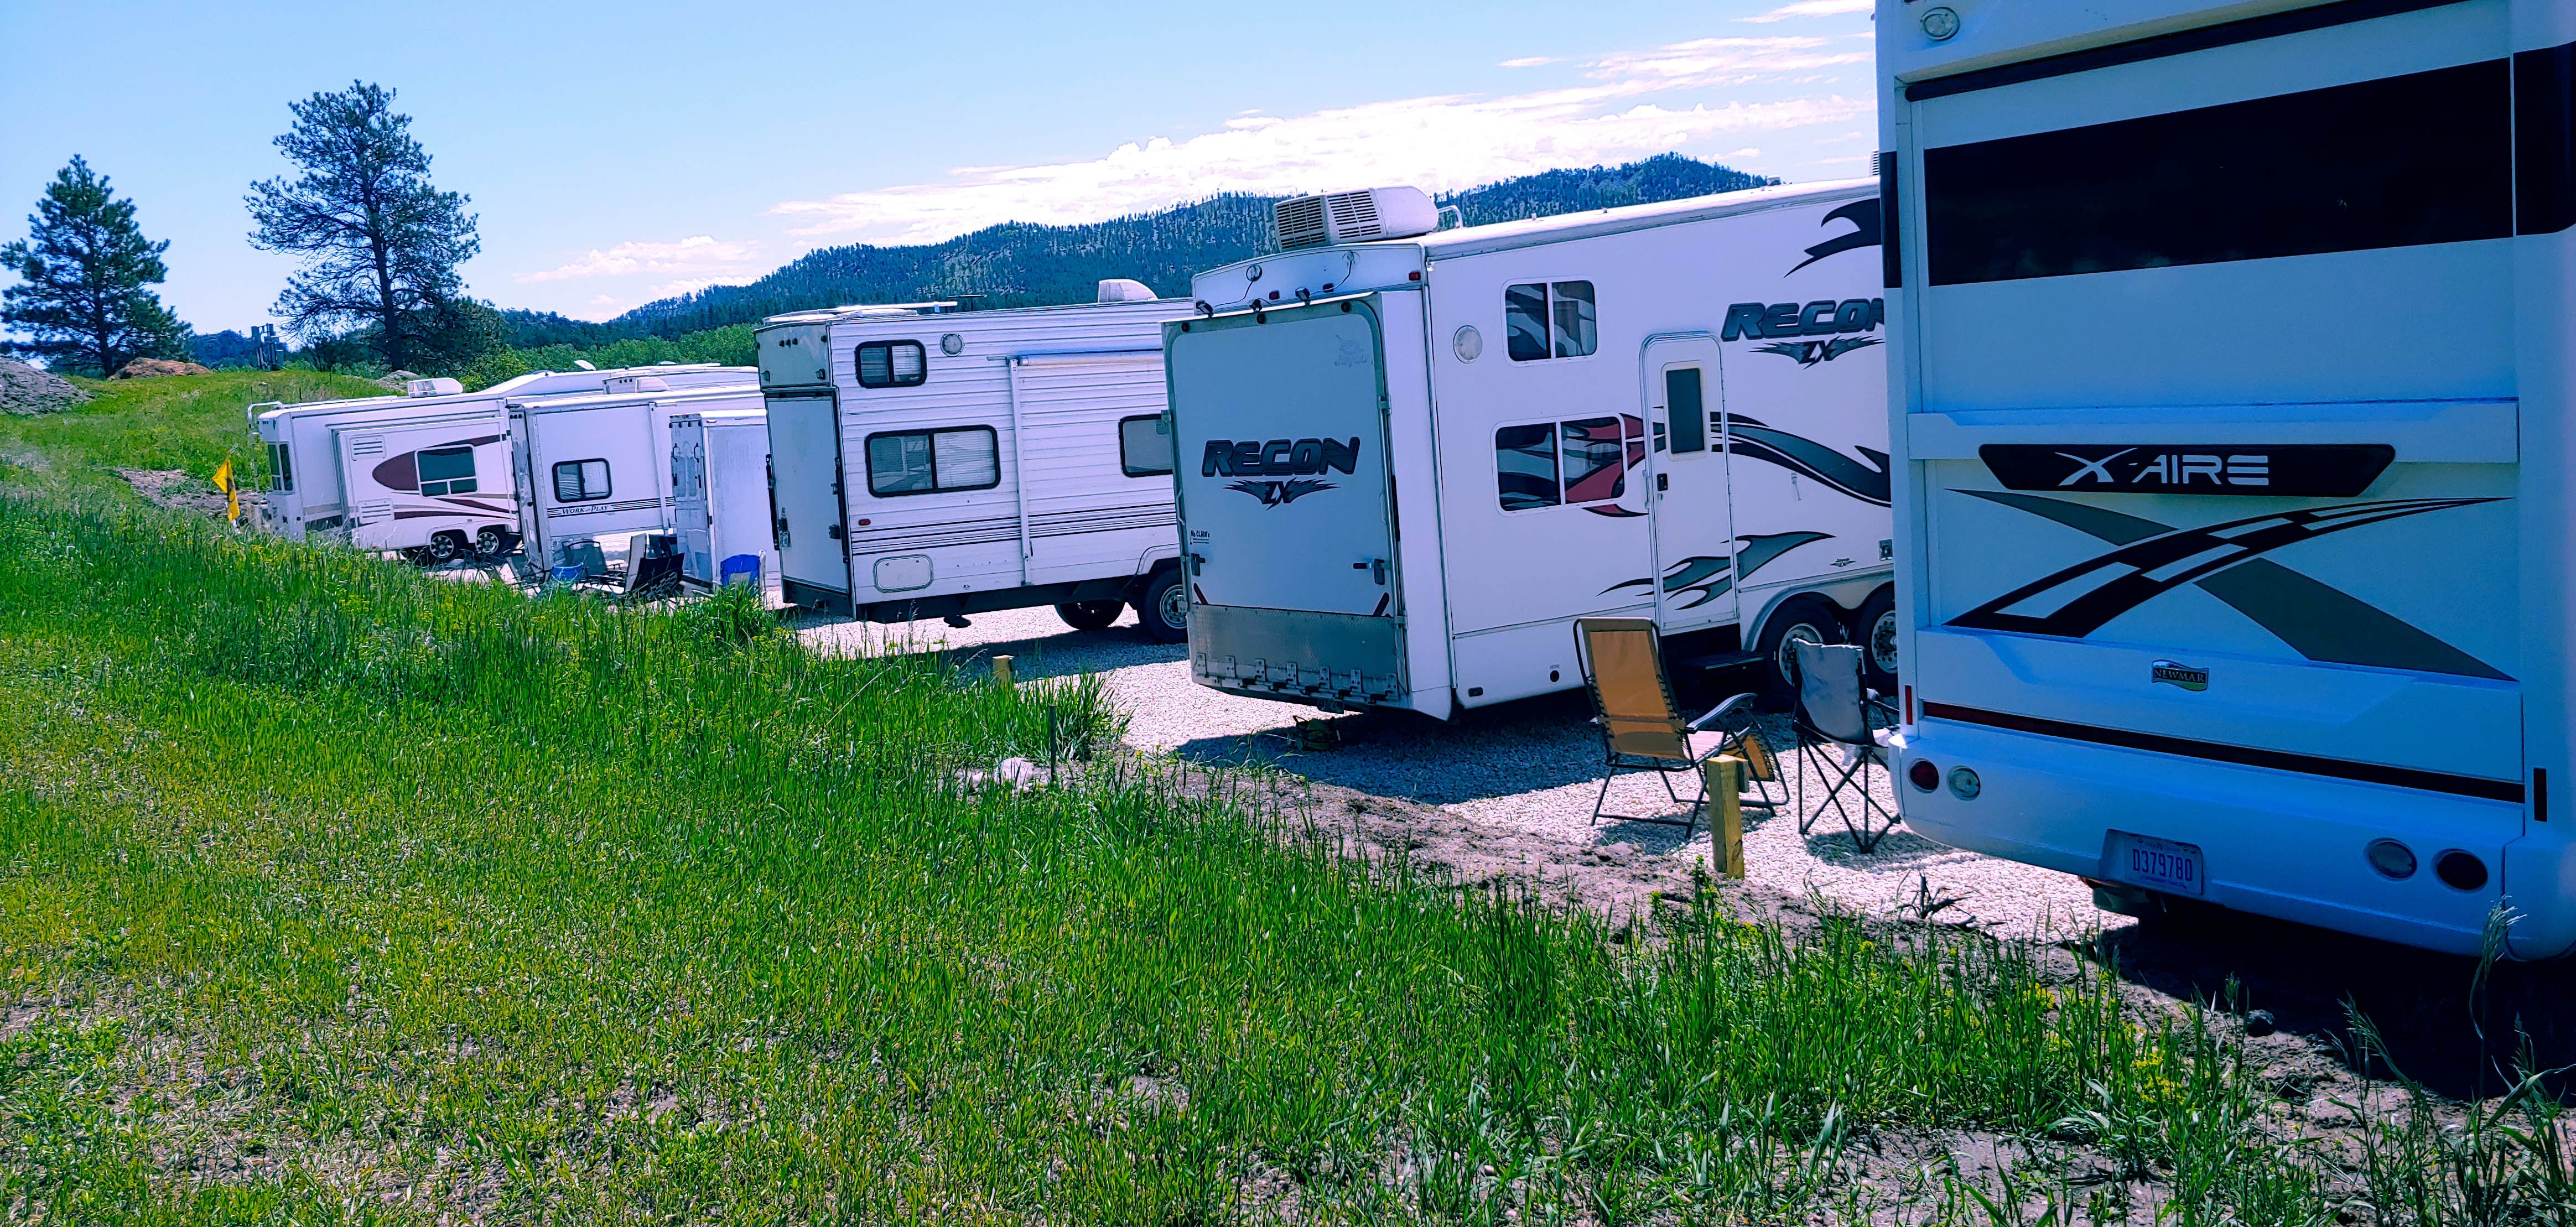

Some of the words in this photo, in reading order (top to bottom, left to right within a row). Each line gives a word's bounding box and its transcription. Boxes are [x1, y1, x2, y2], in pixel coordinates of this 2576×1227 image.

[1201, 436, 1360, 477] RECON
[2154, 669, 2205, 682] NEWMAR
[2133, 848, 2193, 882] D379780
